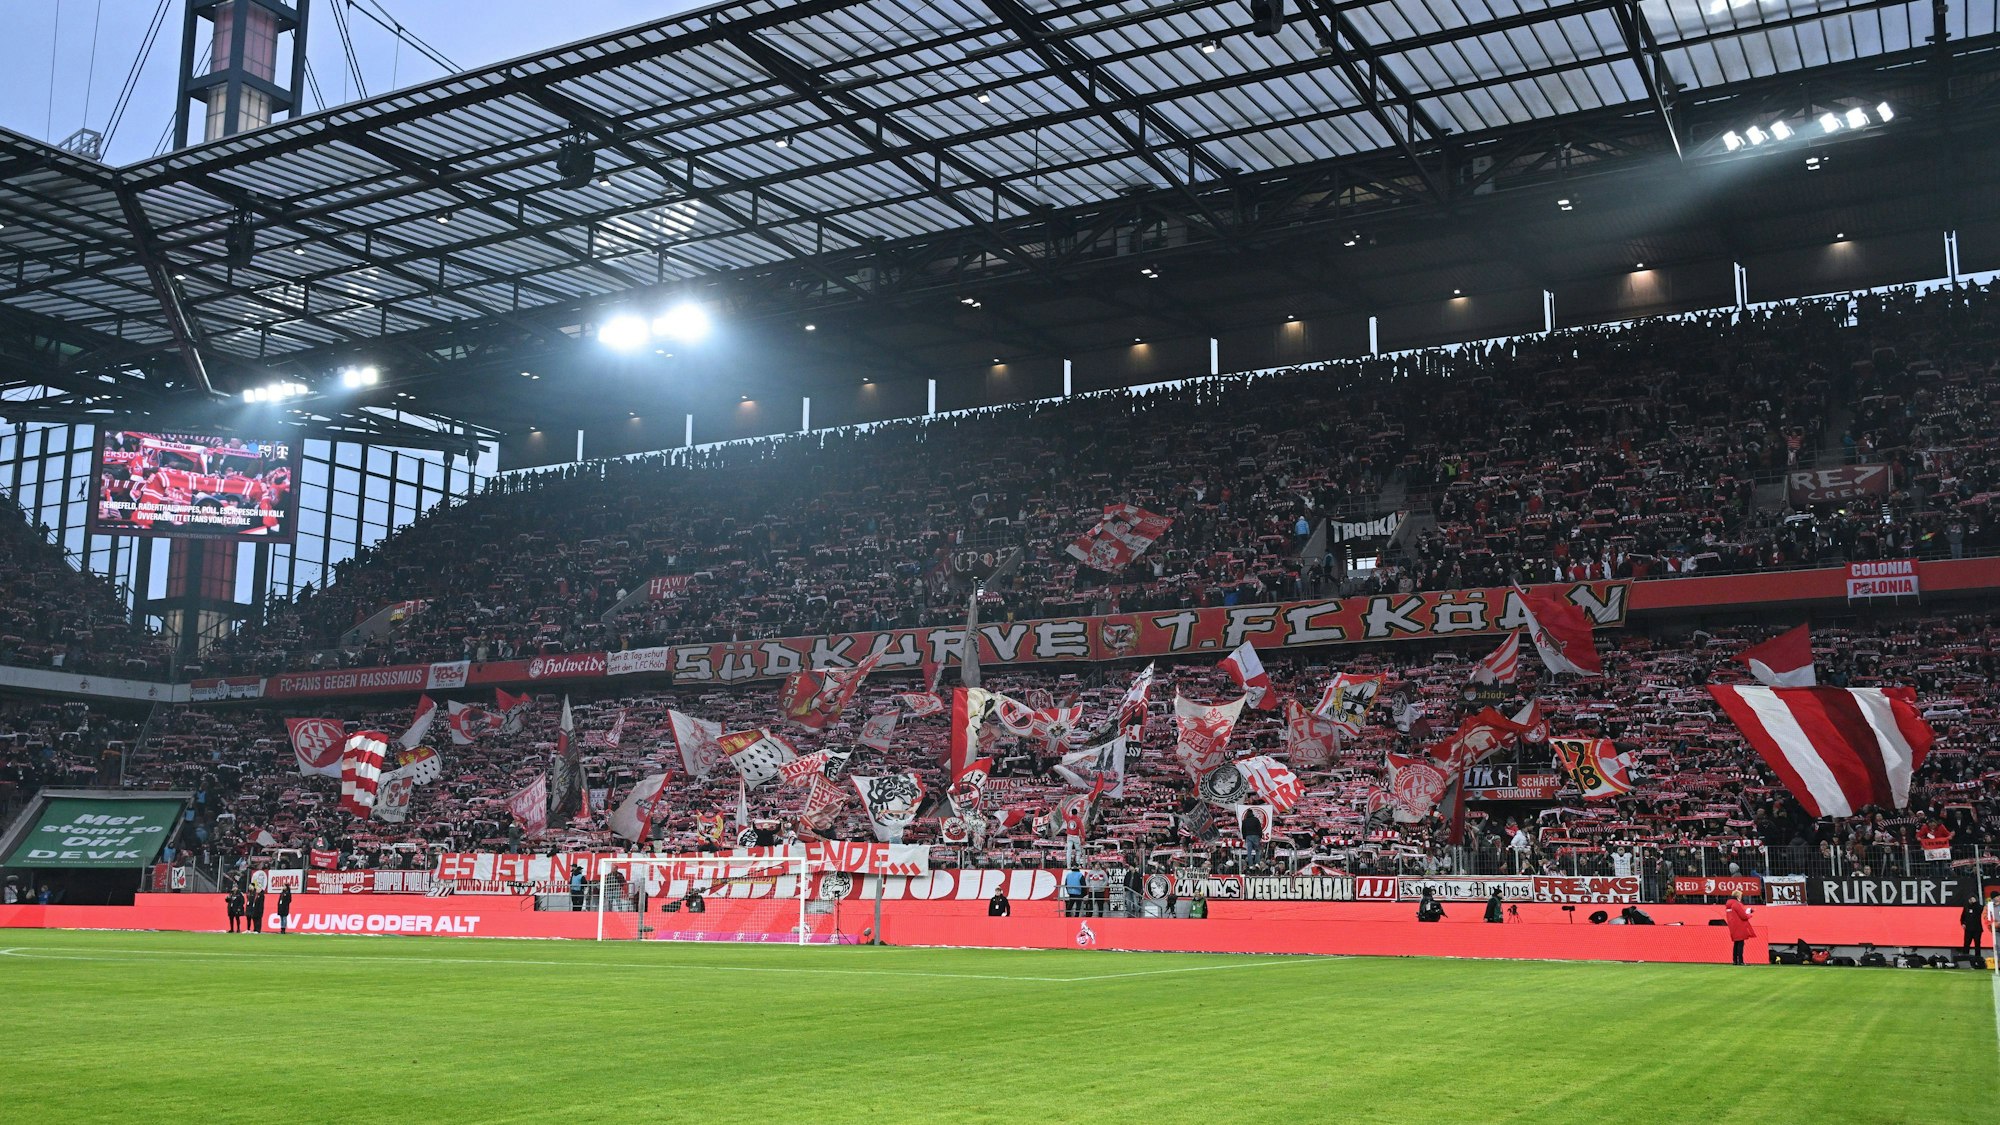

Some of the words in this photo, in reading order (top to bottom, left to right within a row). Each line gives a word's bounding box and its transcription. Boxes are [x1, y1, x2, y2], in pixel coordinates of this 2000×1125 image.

[257, 444, 272, 452] FC
[202, 505, 219, 517] POLL,
[258, 508, 269, 518] UN
[269, 508, 285, 519] KALK
[182, 515, 191, 524] ET
[191, 515, 208, 525] FANS
[208, 516, 223, 526] VOM
[223, 517, 231, 526] FC
[1330, 512, 1398, 543] TROIKA
[1851, 560, 1913, 577] COLONIA
[674, 621, 1090, 683] SÜDKURVE
[1153, 600, 1346, 652] 1.FC
[631, 651, 642, 662] Tag
[543, 656, 606, 677] Holweide
[622, 663, 633, 672] den
[279, 674, 321, 693] FC-FANS
[323, 671, 358, 690] GEGEN
[360, 668, 423, 687] RASSISMUS
[1521, 775, 1561, 787] SCHÄFER
[73, 813, 146, 826] Mer
[41, 824, 127, 835] stonn
[129, 825, 164, 835] zo
[62, 836, 136, 848] Dir!
[27, 849, 143, 860] DEVK
[437, 852, 478, 880] ES
[491, 852, 536, 882] IST
[374, 871, 402, 892] SEMPER
[403, 871, 431, 892] FIDELIS
[1245, 876, 1354, 901] VEEDELSRADAU
[1358, 878, 1395, 898] AJJ
[1534, 877, 1639, 895] FREAKS
[1675, 881, 1699, 892] RED
[1717, 881, 1760, 893] GOATS
[1535, 893, 1639, 903] COLOGNE
[1771, 885, 1795, 901] FC
[1822, 879, 1958, 905] RURDORF
[302, 913, 364, 931] JUNG
[366, 913, 433, 932] ODER
[434, 914, 481, 933] ALT
